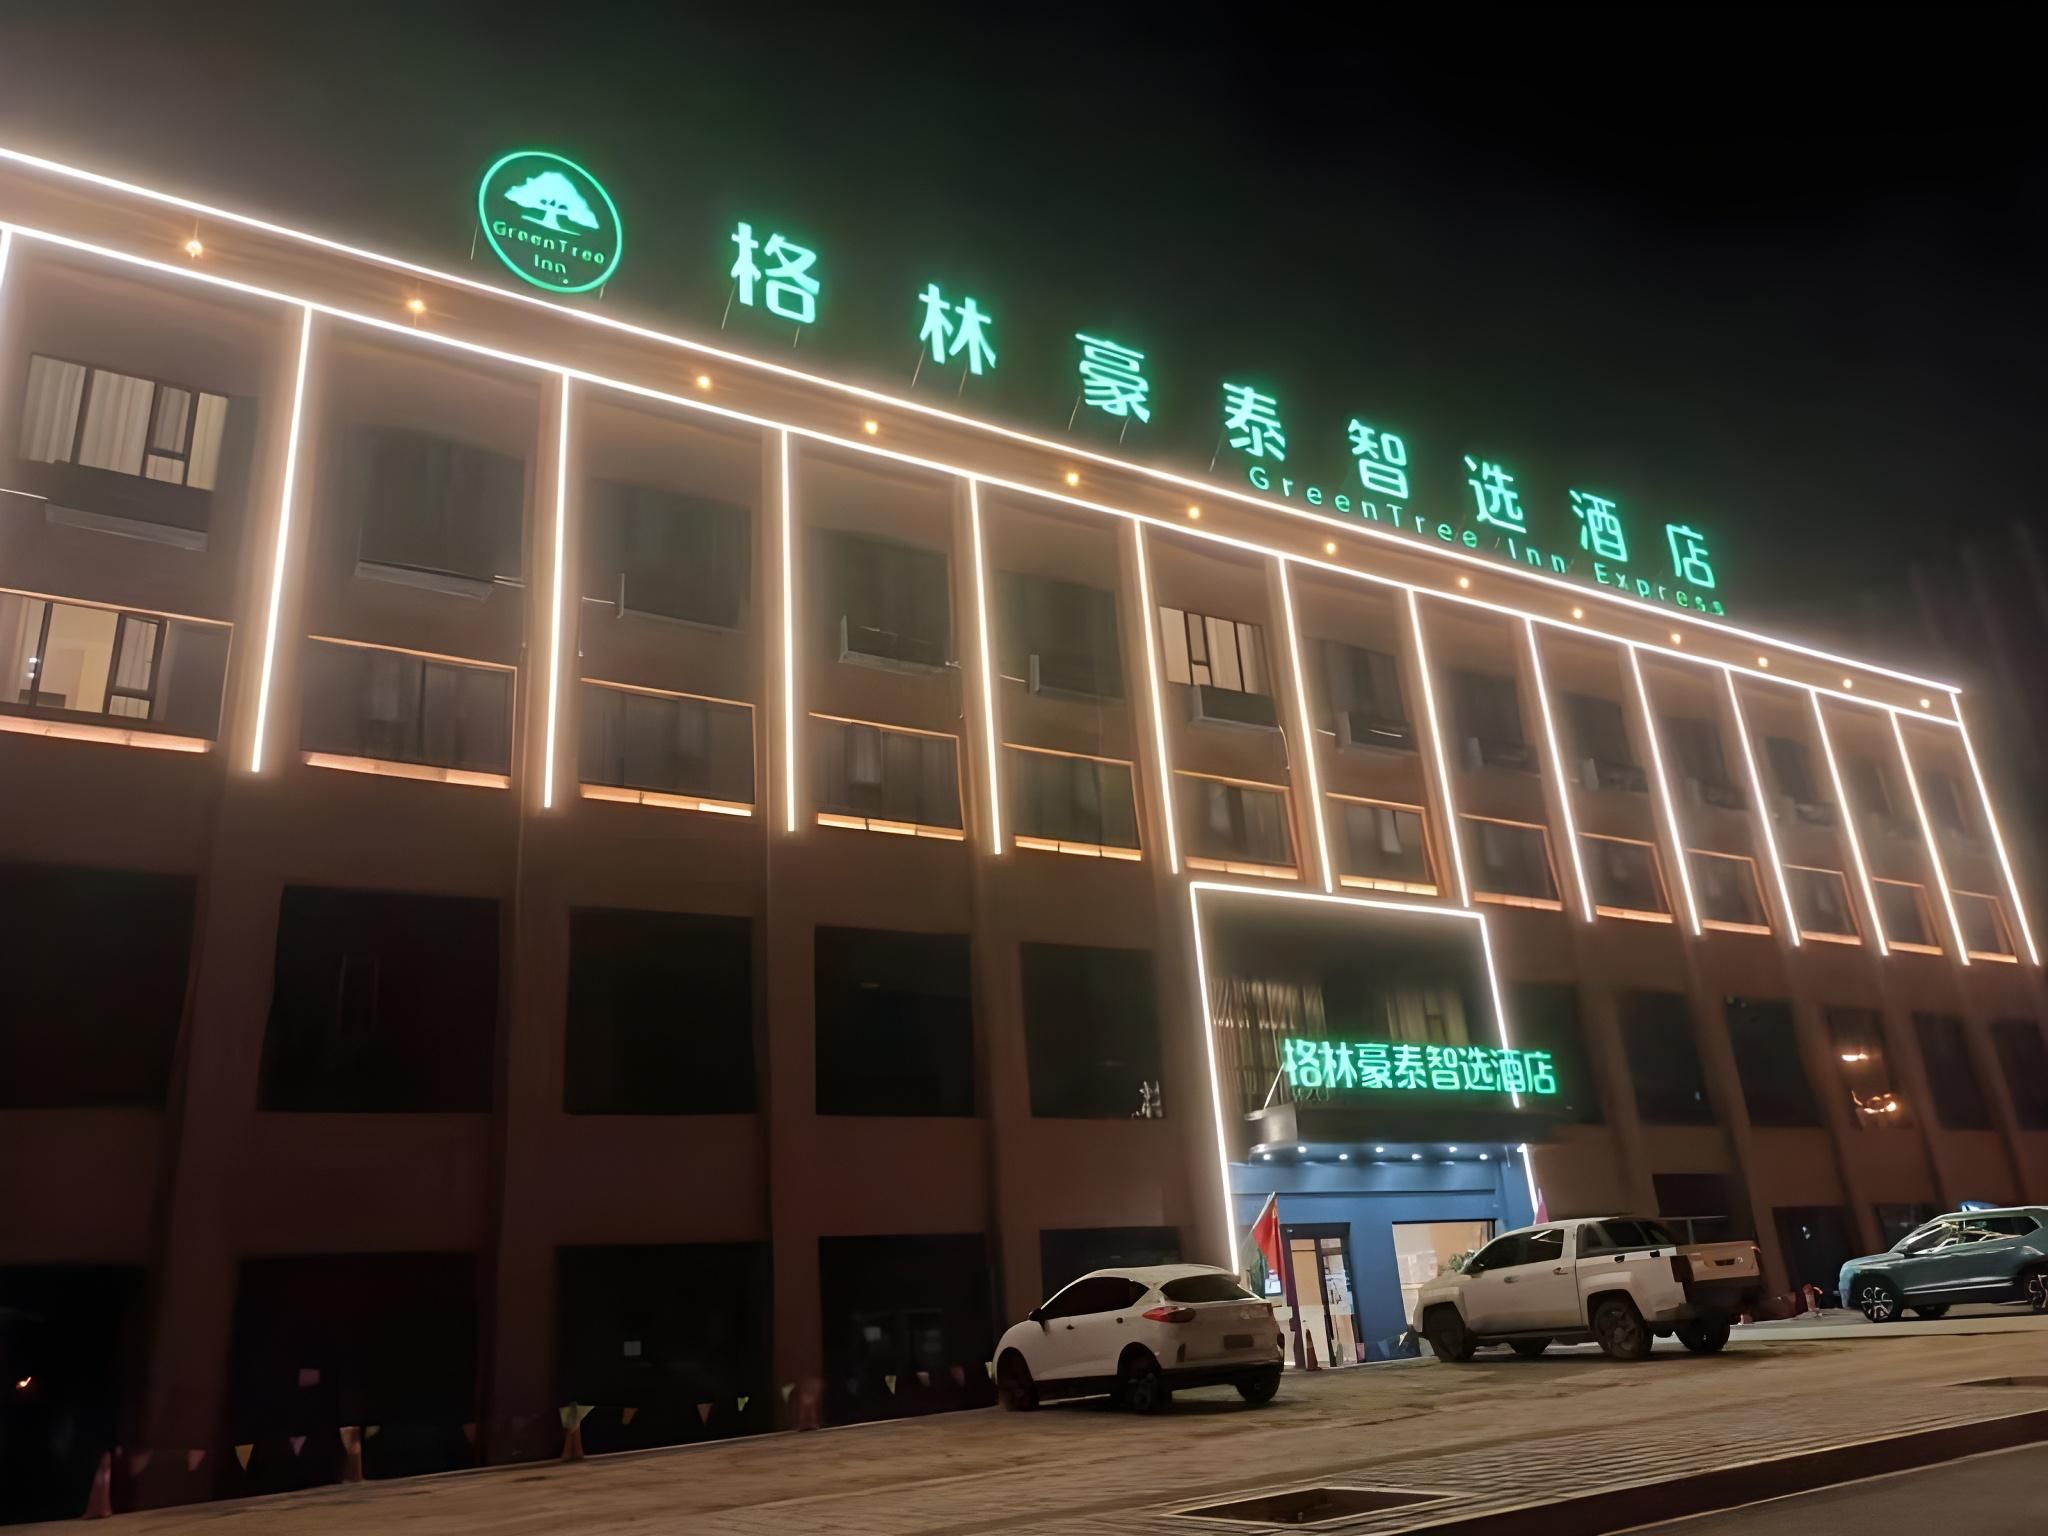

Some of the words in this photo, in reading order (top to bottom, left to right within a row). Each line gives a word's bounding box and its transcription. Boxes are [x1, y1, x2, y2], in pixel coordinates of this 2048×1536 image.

[493, 220, 605, 264] GreenTree
[534, 253, 567, 274] Inn
[729, 220, 1716, 590] 格林豪泰智选酒店
[1248, 465, 1478, 548] GreenTree
[1507, 537, 1567, 574] Inn
[1593, 561, 1726, 617] Express
[1283, 1037, 1558, 1095] 格林豪泰智选酒店
